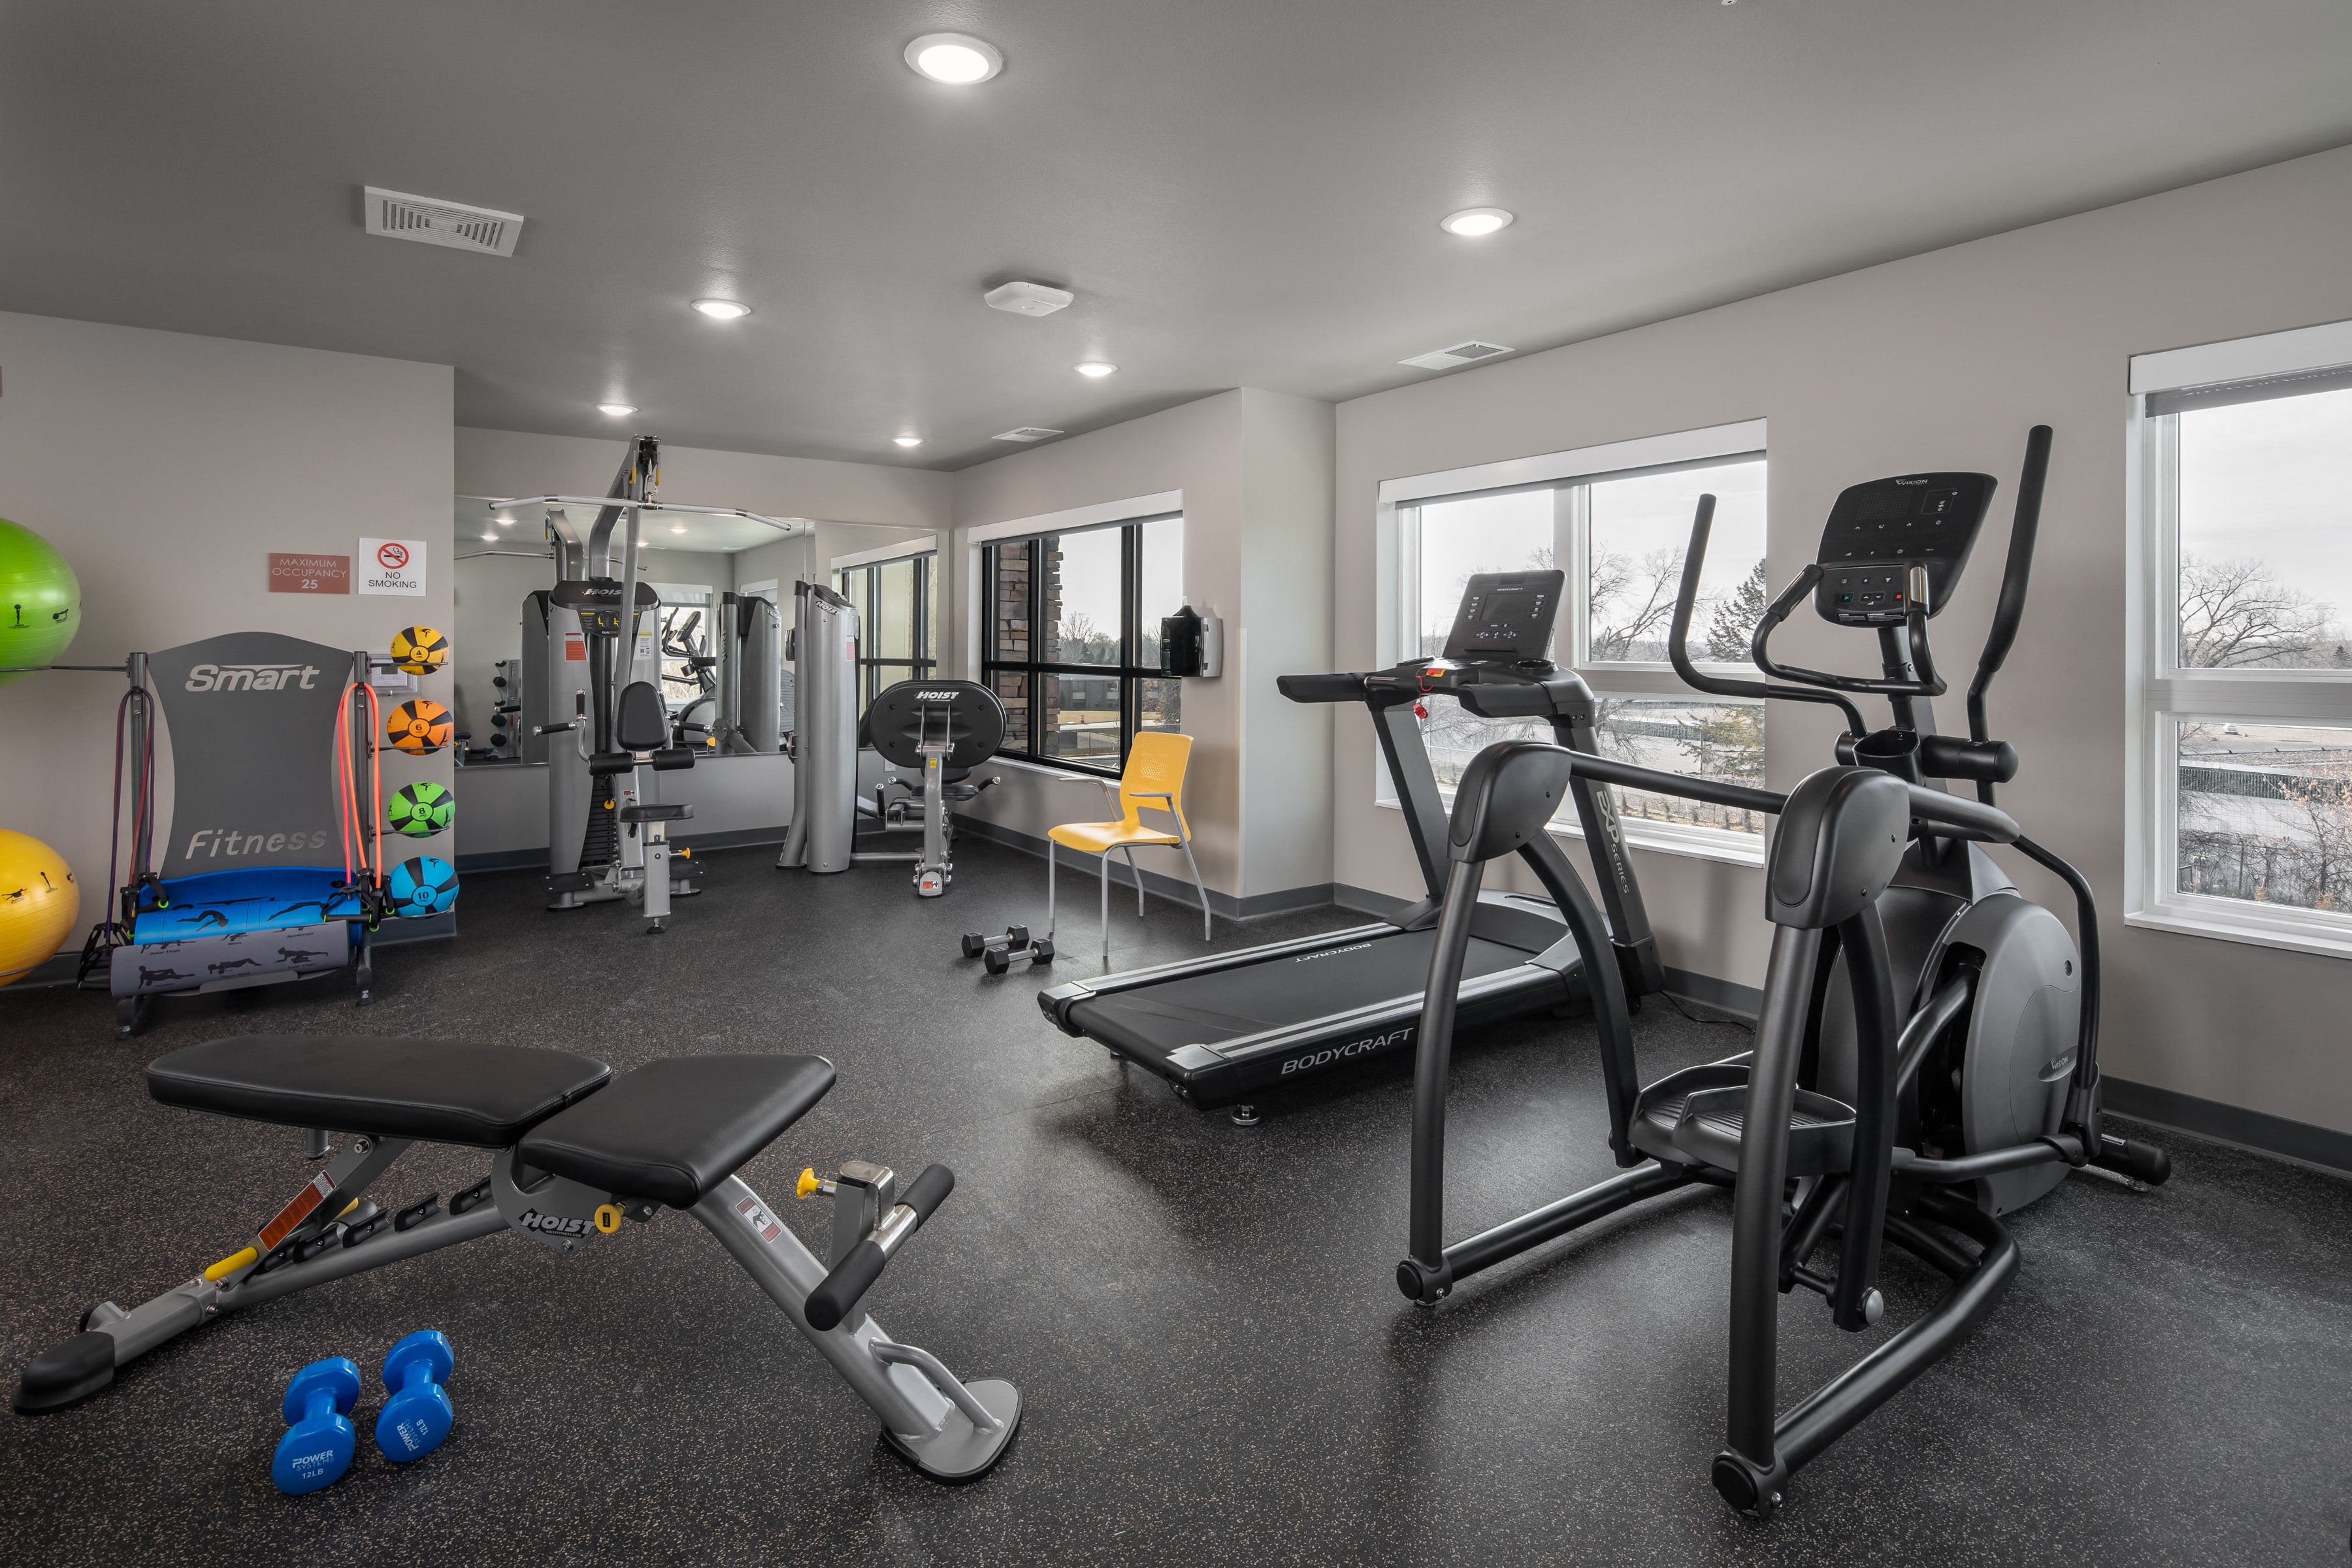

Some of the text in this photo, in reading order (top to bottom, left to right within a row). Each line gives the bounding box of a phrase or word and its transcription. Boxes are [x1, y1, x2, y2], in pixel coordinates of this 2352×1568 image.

[280, 558, 336, 567] MAXIMUM
[272, 567, 346, 578] OCCUPANCY
[301, 579, 318, 589] 25
[368, 580, 417, 588] SMOKING
[815, 600, 841, 616] HOIST
[185, 664, 321, 692] Smart
[916, 691, 960, 700] HOIST
[1596, 789, 1620, 843] EXP
[185, 828, 327, 860] Fitness
[1610, 843, 1629, 894] SERIES
[417, 891, 429, 900] 10
[1295, 943, 1372, 962] BODYCRAFT
[1281, 1028, 1414, 1075] BODYCRAFT
[2053, 1055, 2068, 1070] VISION
[521, 1213, 596, 1234] HOIST
[403, 1418, 421, 1446] SYSTEMS
[416, 1418, 429, 1435] 12LB
[397, 1422, 419, 1452] POWER
[292, 1450, 334, 1469] POWER
[296, 1457, 335, 1471] SYSTEMS
[301, 1468, 324, 1479] 12LB
